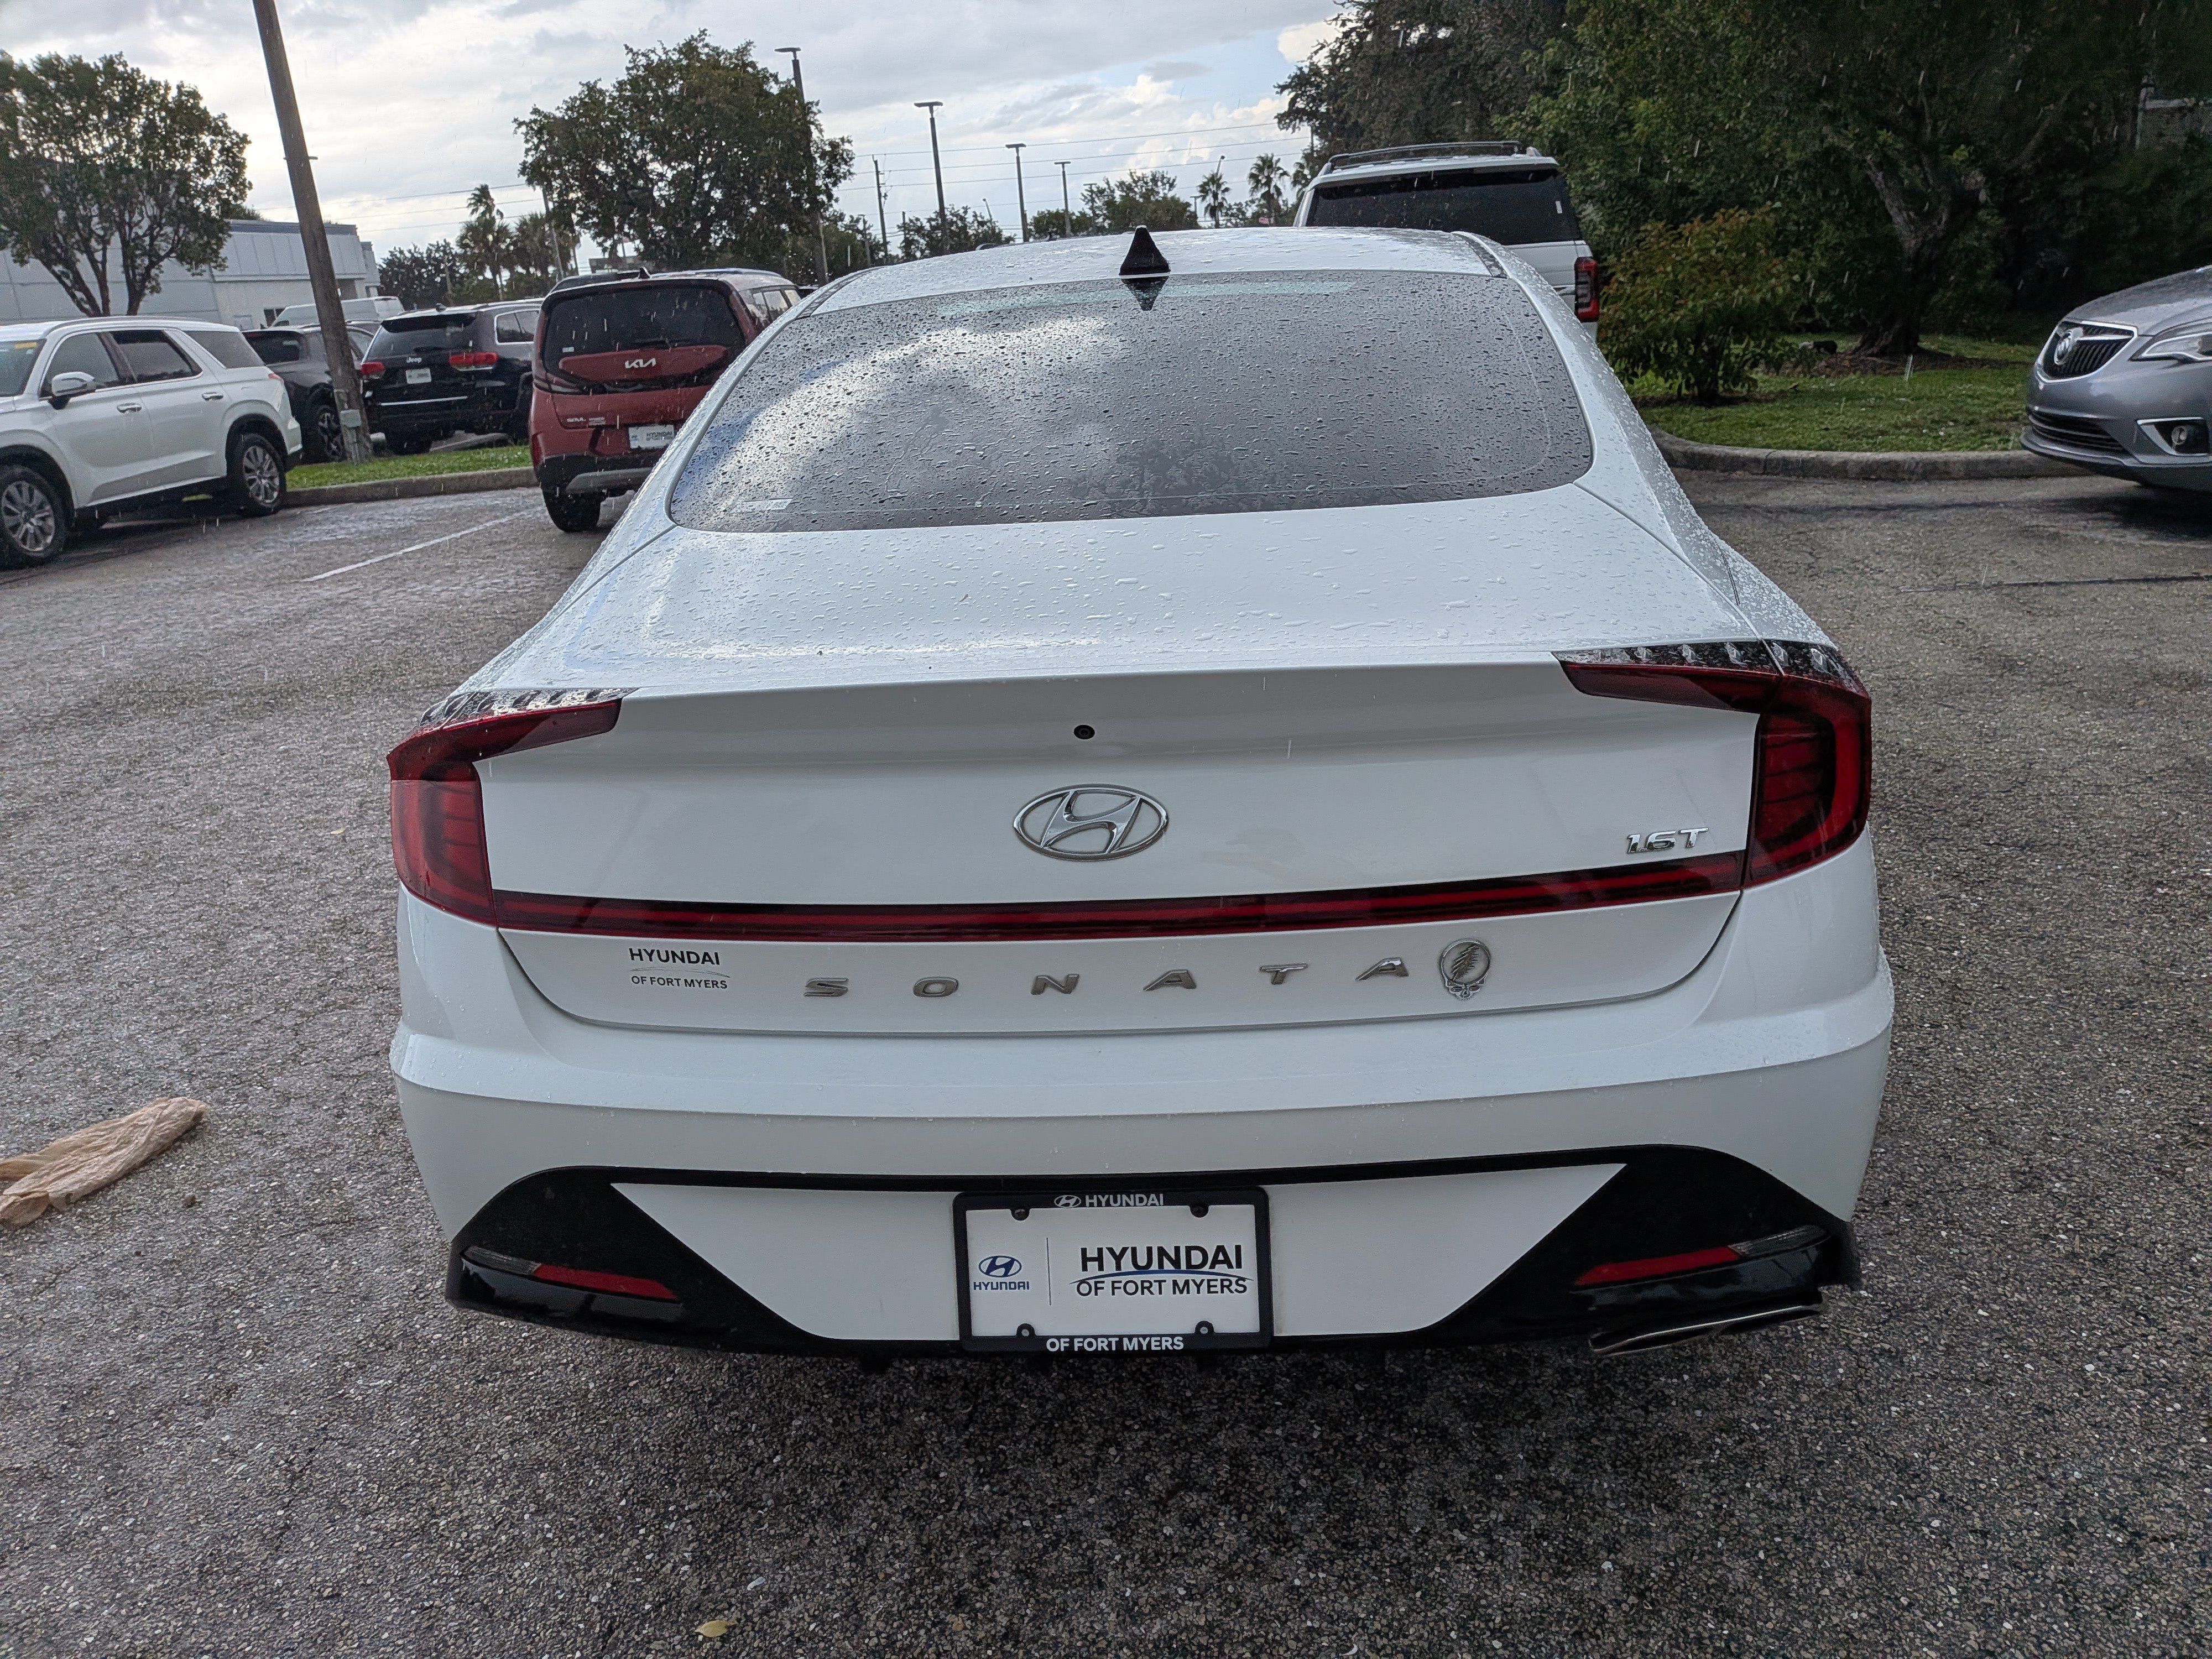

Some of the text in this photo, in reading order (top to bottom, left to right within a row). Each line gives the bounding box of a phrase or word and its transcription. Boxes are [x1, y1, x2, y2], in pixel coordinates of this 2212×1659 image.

[1626, 827, 1709, 854] 1.6T
[629, 948, 721, 965] HYUNDAI
[632, 975, 728, 989] OF FORT MYERS
[804, 957, 1410, 997] SONATA
[1085, 1193, 1164, 1207] HYUNDAI
[1081, 1245, 1242, 1272] HYUNDAI
[973, 1281, 1029, 1291] HYUNDAI
[1077, 1278, 1247, 1296] OF FORT MYERS
[1046, 1337, 1184, 1352] OF FORT MYERS
